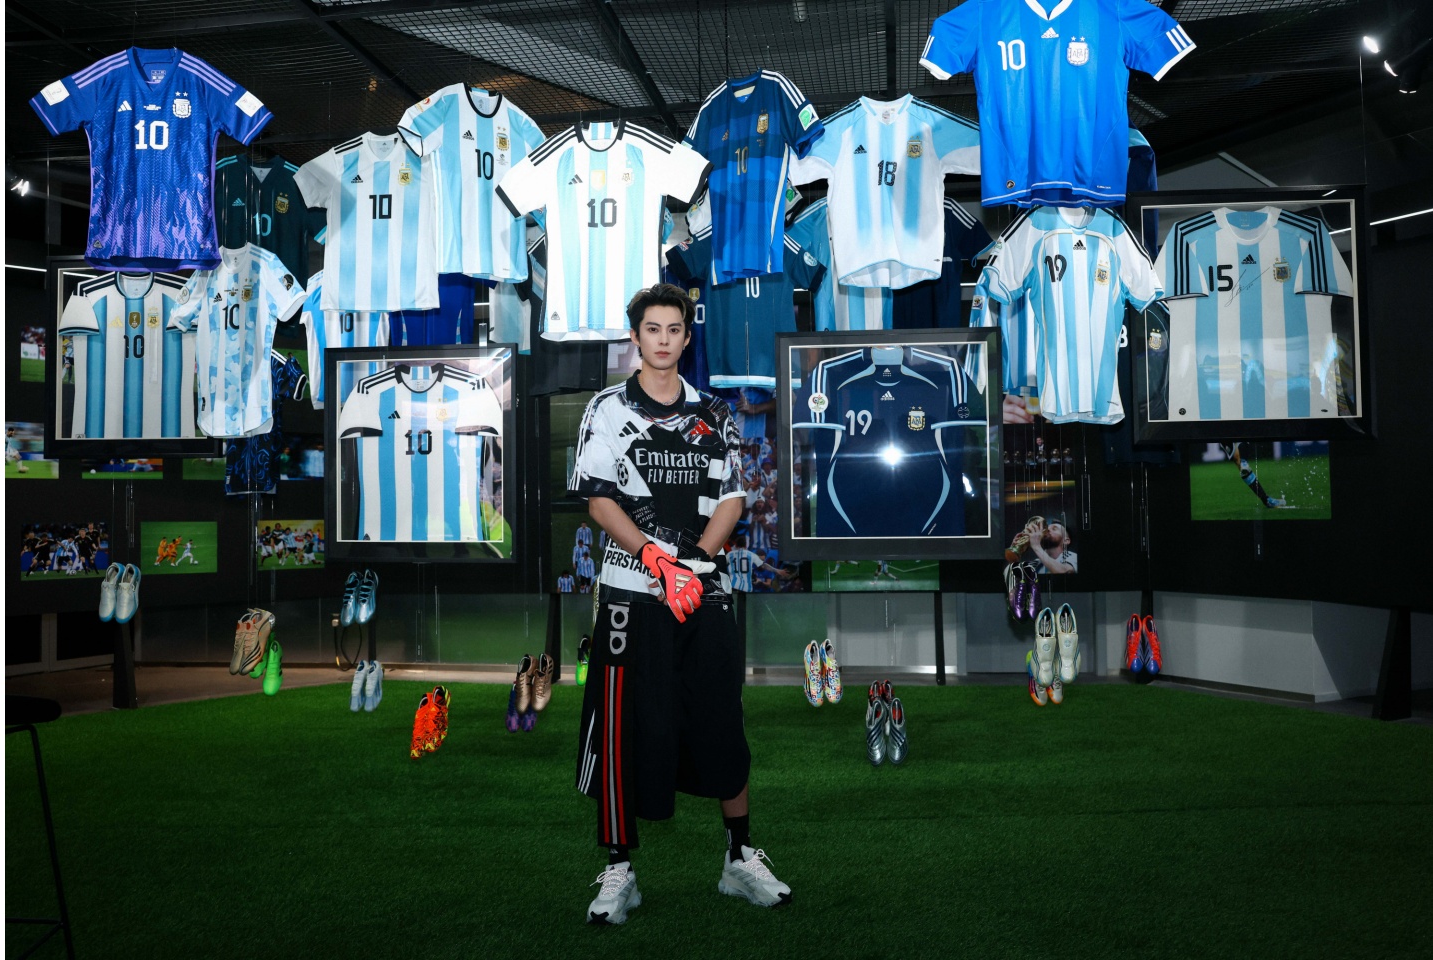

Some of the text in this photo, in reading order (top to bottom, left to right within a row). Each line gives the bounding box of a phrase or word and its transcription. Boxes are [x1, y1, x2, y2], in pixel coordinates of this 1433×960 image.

[997, 39, 1026, 70] 10
[134, 120, 169, 150] 10
[475, 149, 494, 180] 10
[735, 146, 749, 175] 10
[877, 160, 897, 187] 18
[369, 194, 392, 219] 10
[587, 198, 617, 228] 10
[253, 212, 272, 236] 10
[1044, 254, 1067, 282] 19
[1208, 264, 1234, 292] 15
[746, 276, 760, 298] 10
[222, 303, 240, 330] 10
[339, 312, 354, 334] 10
[692, 304, 705, 324] 0
[124, 334, 145, 358] 10
[845, 410, 873, 436] 19
[405, 429, 432, 455] 10
[634, 448, 709, 468] Emirates
[648, 469, 699, 485] FLY BETTER
[732, 557, 751, 574] 10
